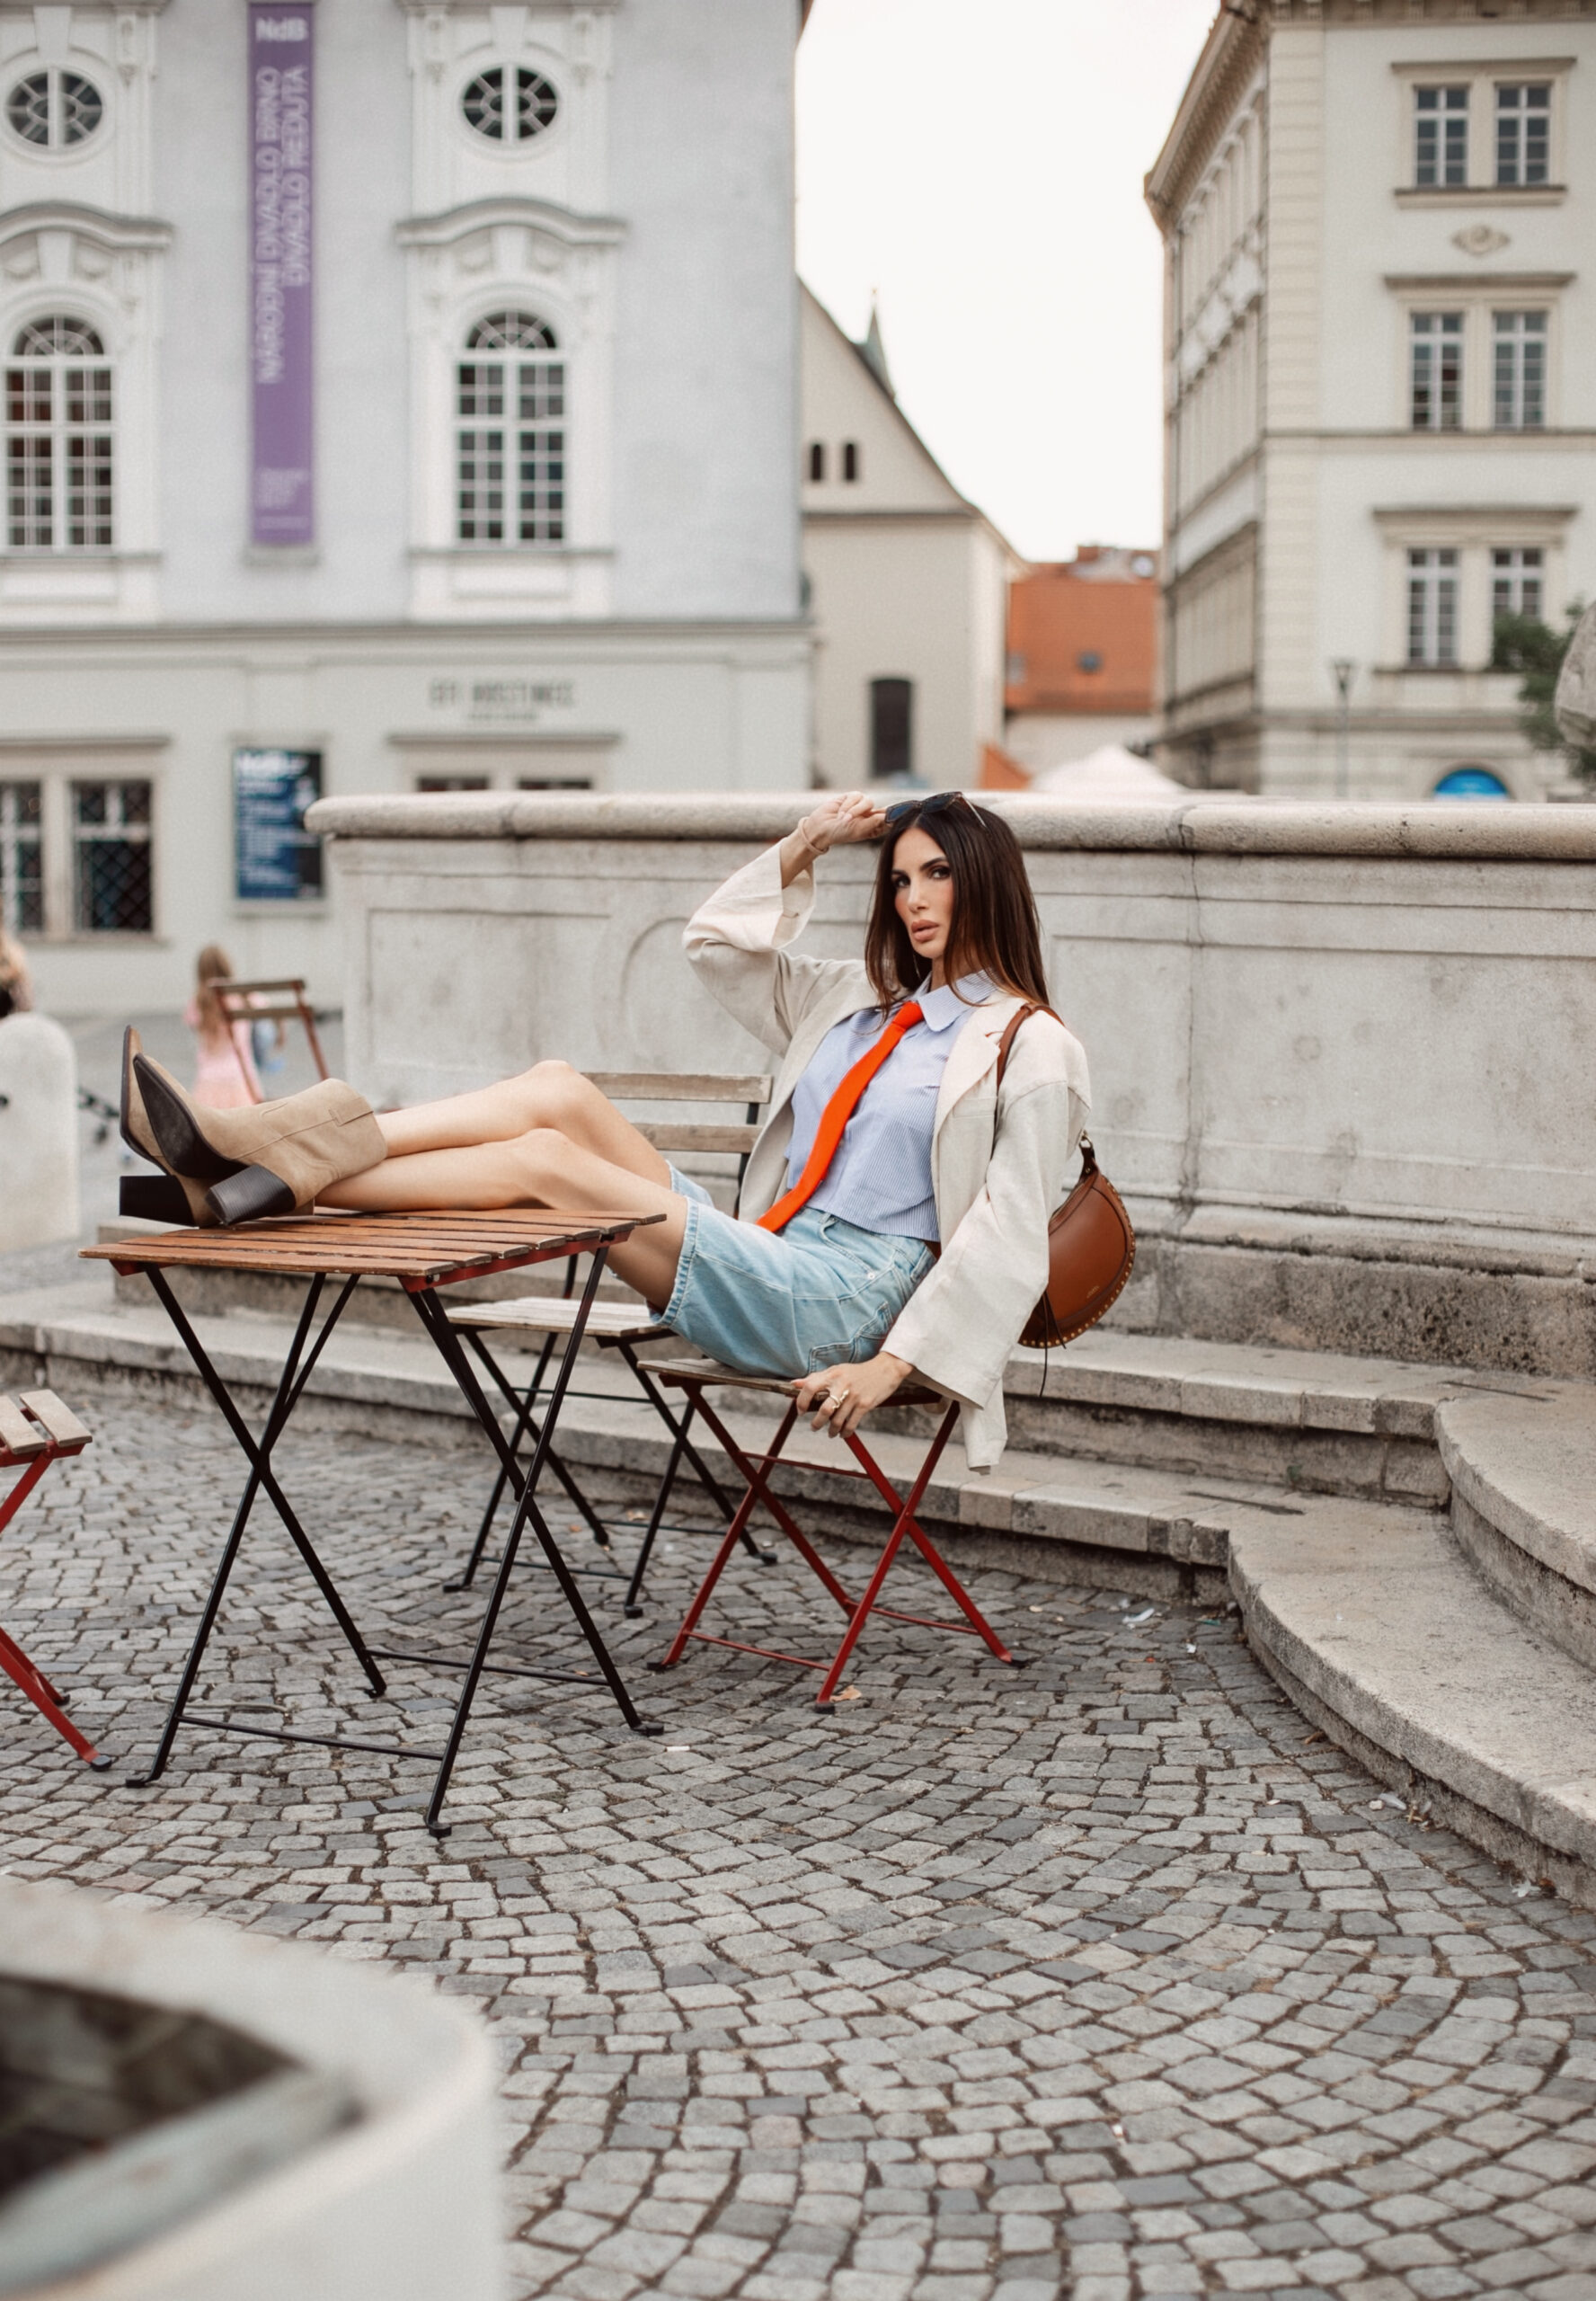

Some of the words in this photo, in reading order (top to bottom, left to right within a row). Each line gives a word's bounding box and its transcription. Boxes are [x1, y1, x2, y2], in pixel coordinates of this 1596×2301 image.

[255, 17, 308, 41] NdB
[255, 66, 282, 141] BRNO
[281, 64, 310, 168] REDUTA
[255, 147, 283, 261] DIVADLO
[281, 171, 309, 286] DIVADLO
